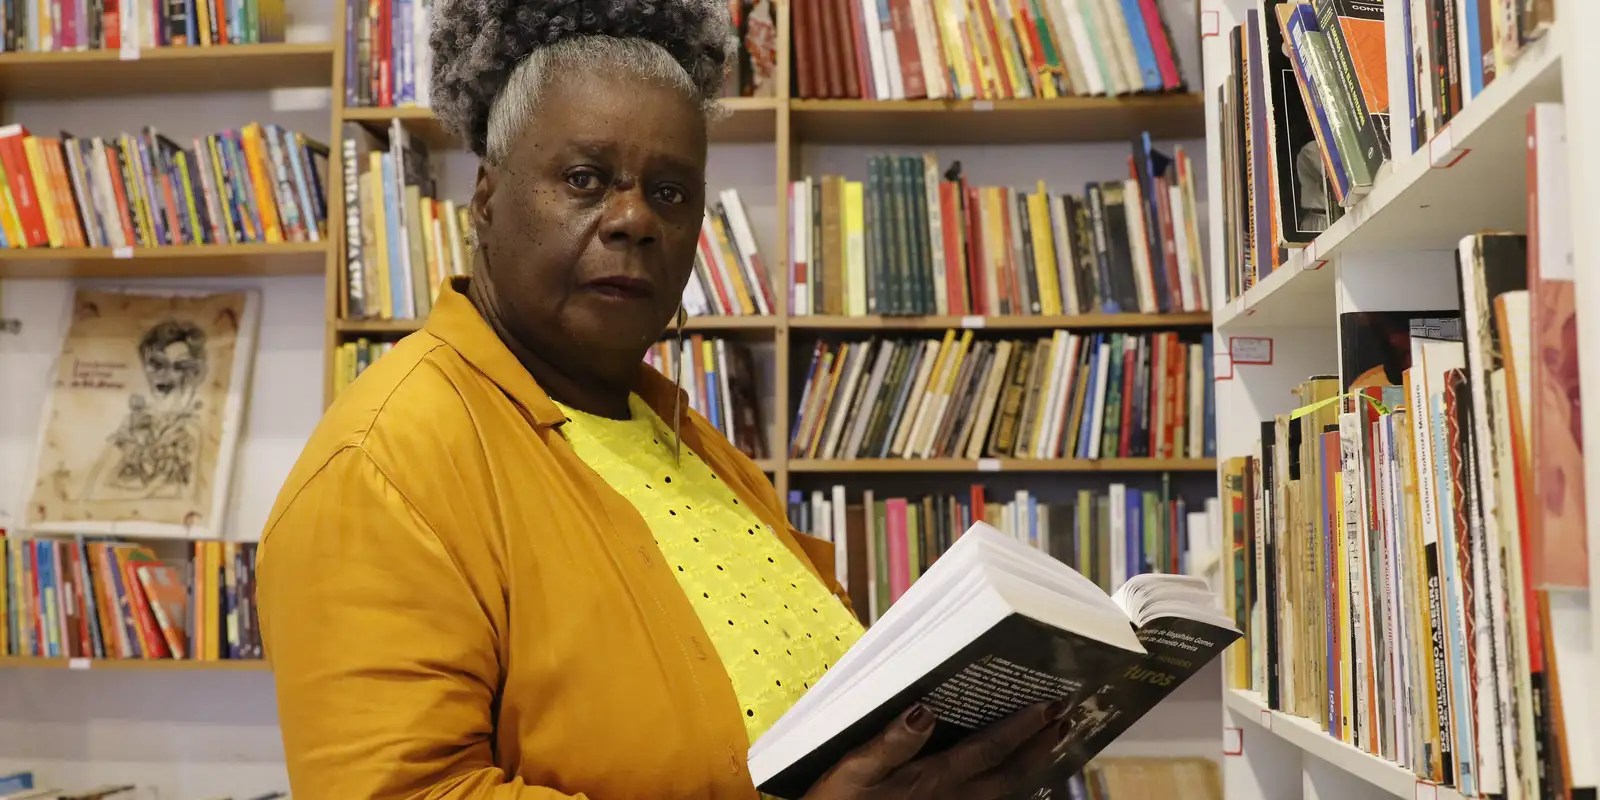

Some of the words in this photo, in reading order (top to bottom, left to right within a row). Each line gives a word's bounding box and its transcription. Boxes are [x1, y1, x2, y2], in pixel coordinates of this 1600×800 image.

[1415, 384, 1424, 429] Monteiro
[1428, 577, 1437, 628] SERRA
[1178, 642, 1198, 652] Pereira
[1194, 637, 1214, 648] Gomes
[1433, 646, 1444, 727] QUILOMBO
[1440, 731, 1446, 753] DO
